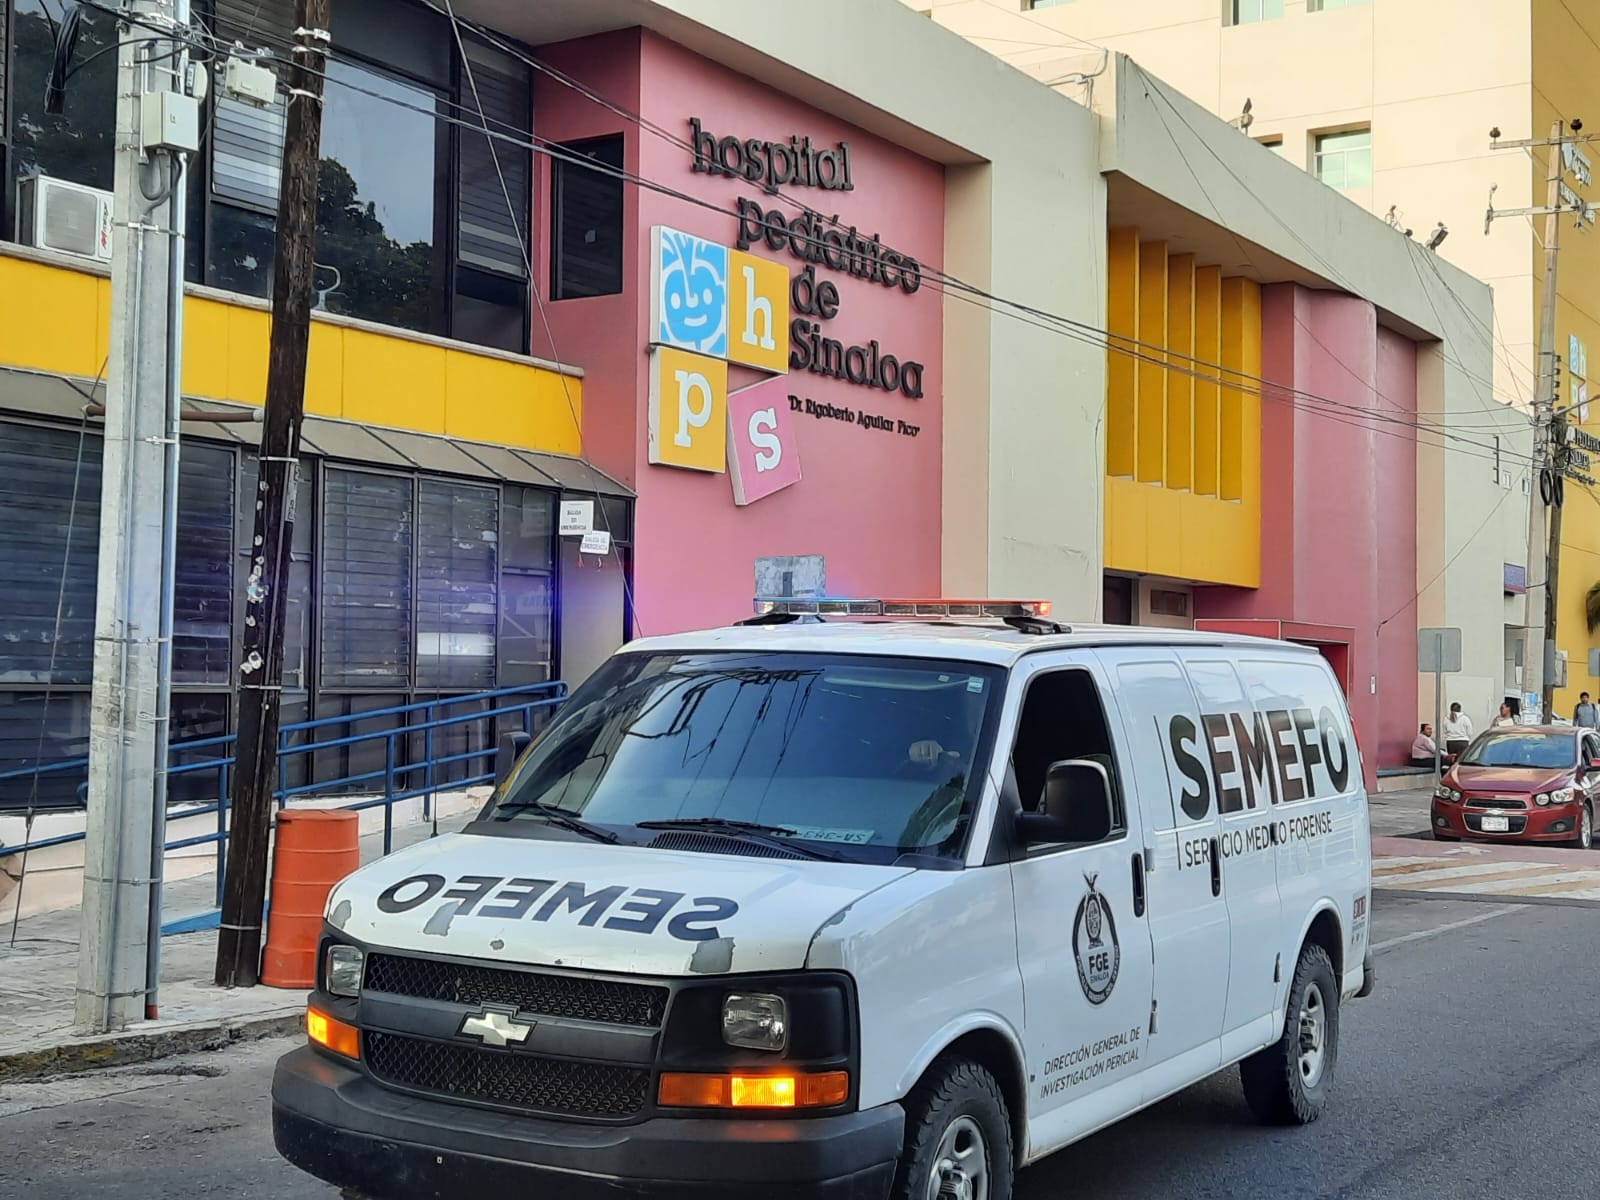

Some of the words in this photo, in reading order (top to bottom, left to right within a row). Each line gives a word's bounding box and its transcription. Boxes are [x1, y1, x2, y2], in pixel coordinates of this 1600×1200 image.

[688, 117, 854, 194] hospital
[737, 197, 920, 294] pediátrico
[743, 265, 775, 350] h
[792, 264, 839, 319] de
[788, 318, 924, 398] Sinaloa
[674, 370, 712, 448] p
[805, 398, 855, 423] Rigoberto
[857, 410, 895, 432] Aguilar
[1169, 706, 1349, 821] SEMEFO
[1185, 830, 1243, 868] SERICIO
[1289, 811, 1333, 843] FORENSE
[1088, 952, 1110, 975] FGE
[1040, 1060, 1105, 1099] INVESTIGACIÓN
[1105, 1047, 1139, 1073] PERICIAL
[1044, 1044, 1091, 1075] DIRECCIÓN
[1092, 1033, 1128, 1056] GENERAL
[1130, 1026, 1141, 1042] DE
